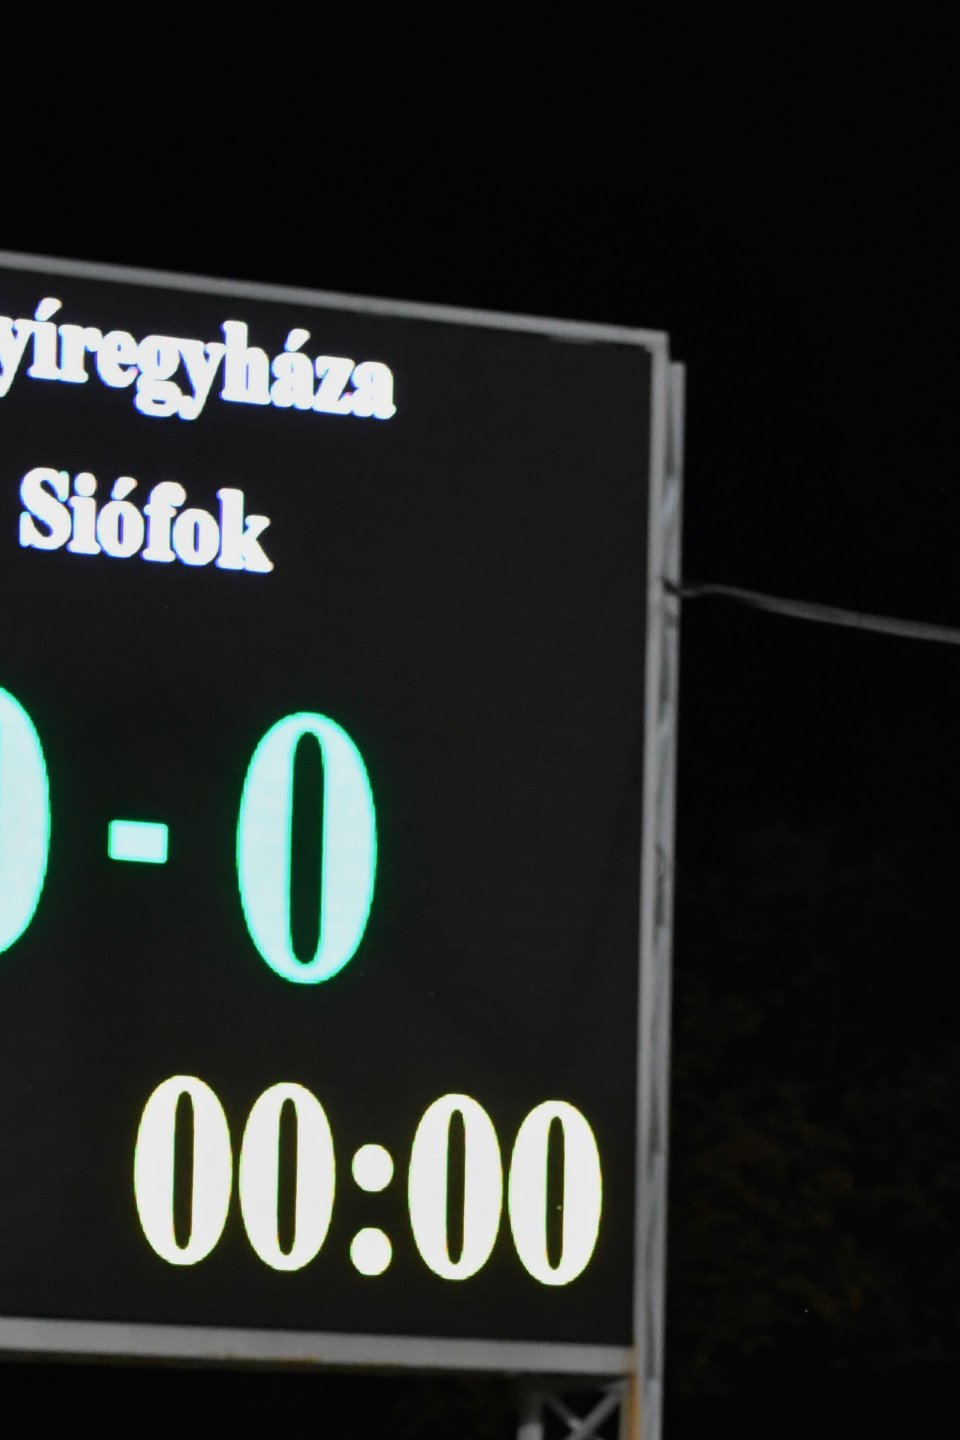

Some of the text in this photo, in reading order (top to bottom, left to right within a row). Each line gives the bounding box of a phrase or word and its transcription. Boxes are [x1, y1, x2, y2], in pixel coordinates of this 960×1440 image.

[18, 466, 274, 574] Siófok
[236, 711, 379, 985] 0
[133, 1074, 603, 1286] 00:00
